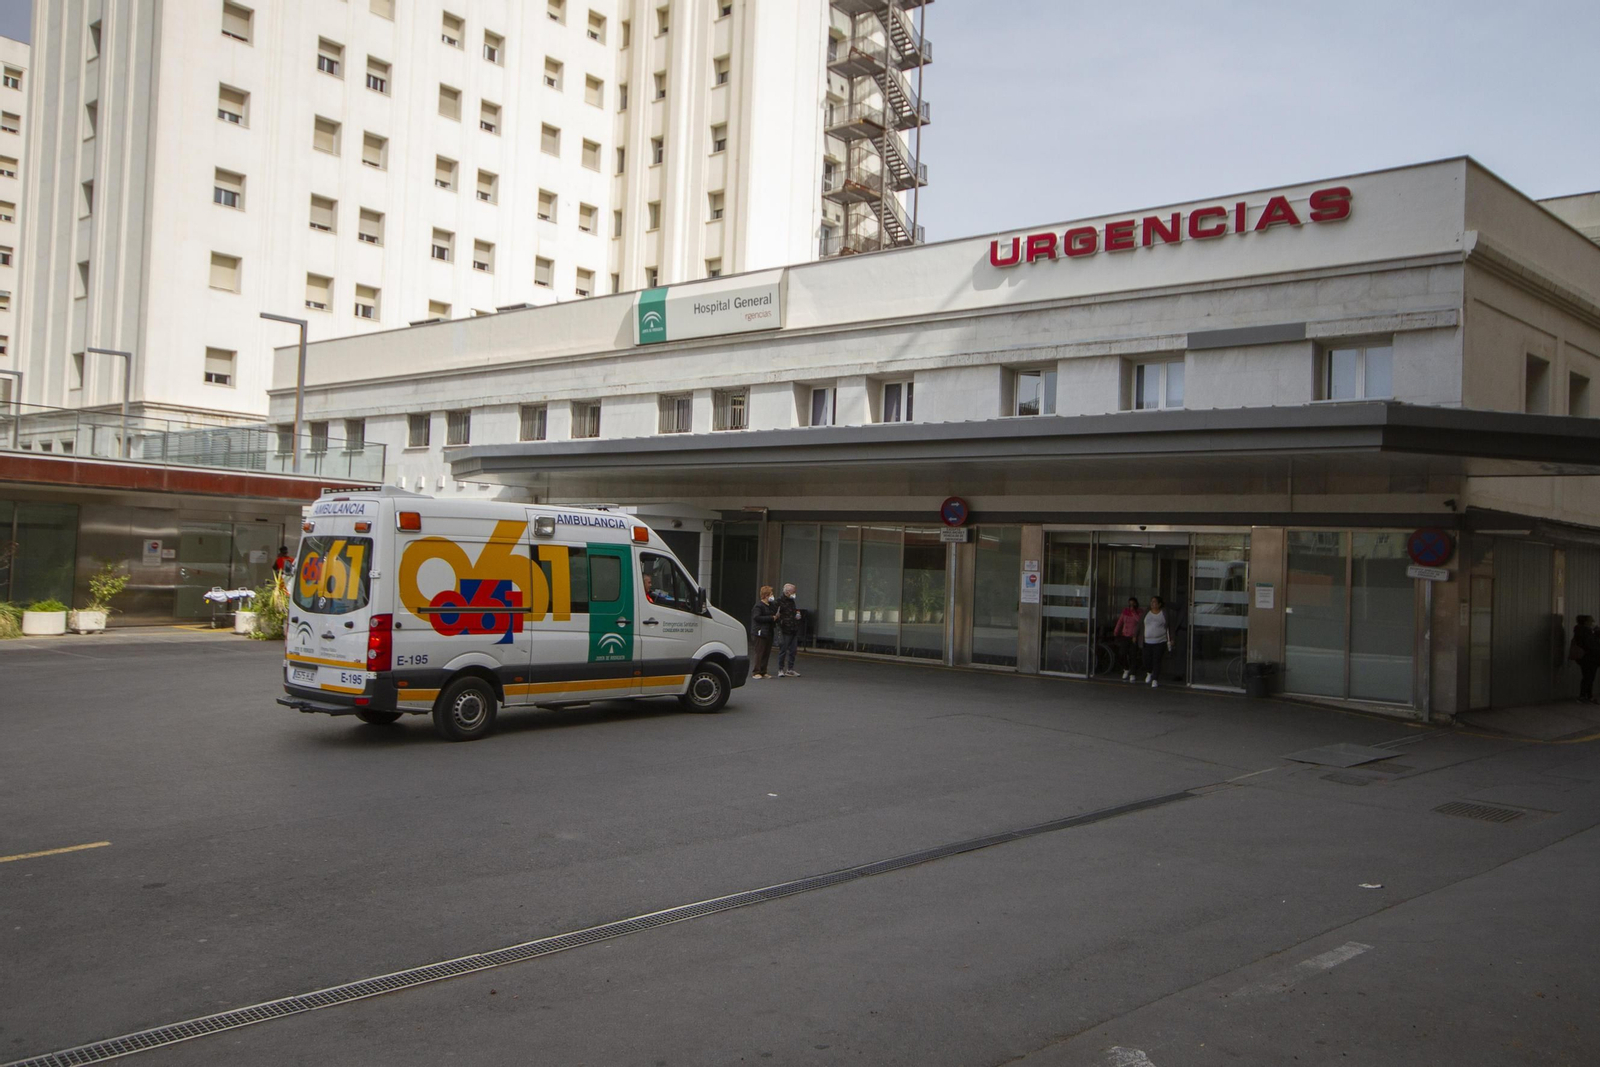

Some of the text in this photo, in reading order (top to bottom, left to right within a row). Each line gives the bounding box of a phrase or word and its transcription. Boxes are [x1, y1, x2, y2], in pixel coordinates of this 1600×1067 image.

[990, 186, 1352, 268] URGENCIAS
[694, 292, 772, 315] Hospital General
[314, 502, 366, 515] AMBULANCIA
[556, 513, 626, 529] AMBULANCIA
[300, 540, 365, 600] 061
[399, 519, 571, 623] 061
[429, 579, 524, 637] 061
[397, 654, 428, 666] E-195
[341, 672, 362, 685] E-195
